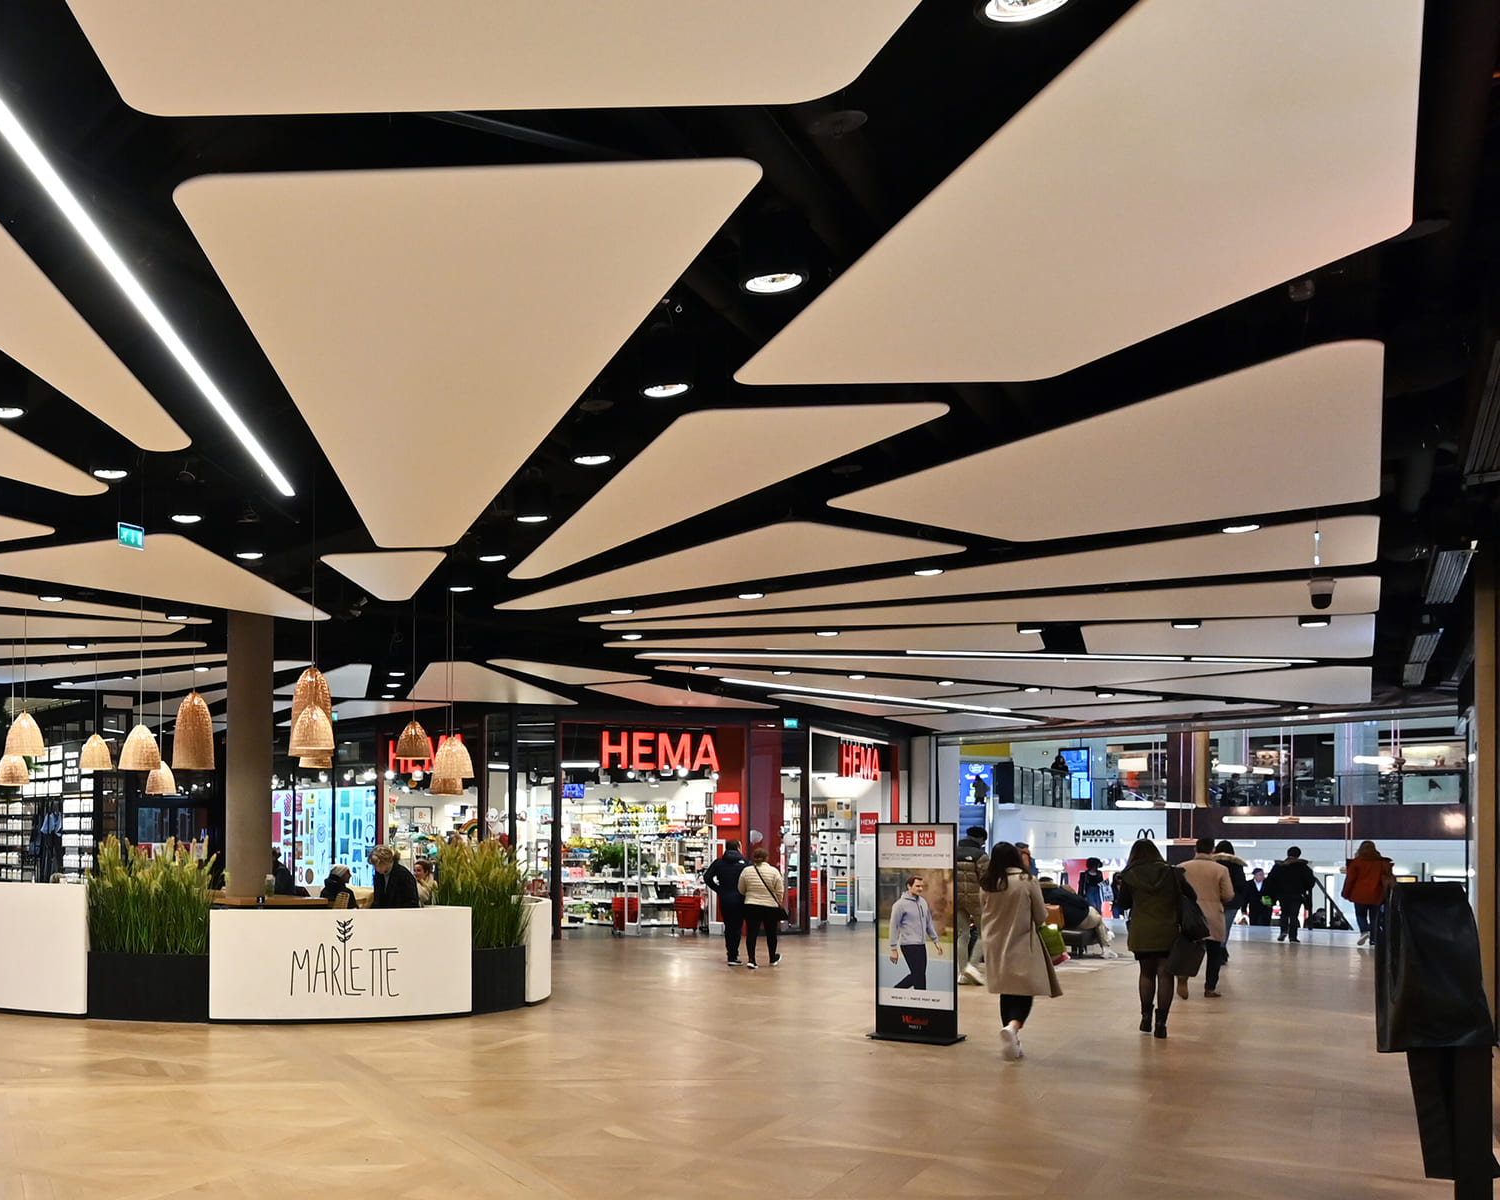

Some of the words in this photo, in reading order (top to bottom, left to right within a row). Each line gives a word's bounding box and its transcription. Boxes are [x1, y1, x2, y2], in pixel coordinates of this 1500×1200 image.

[602, 731, 719, 771] HEMA
[843, 743, 880, 781] HEMA
[714, 804, 740, 814] HEMA
[290, 943, 399, 998] MARLETTE
